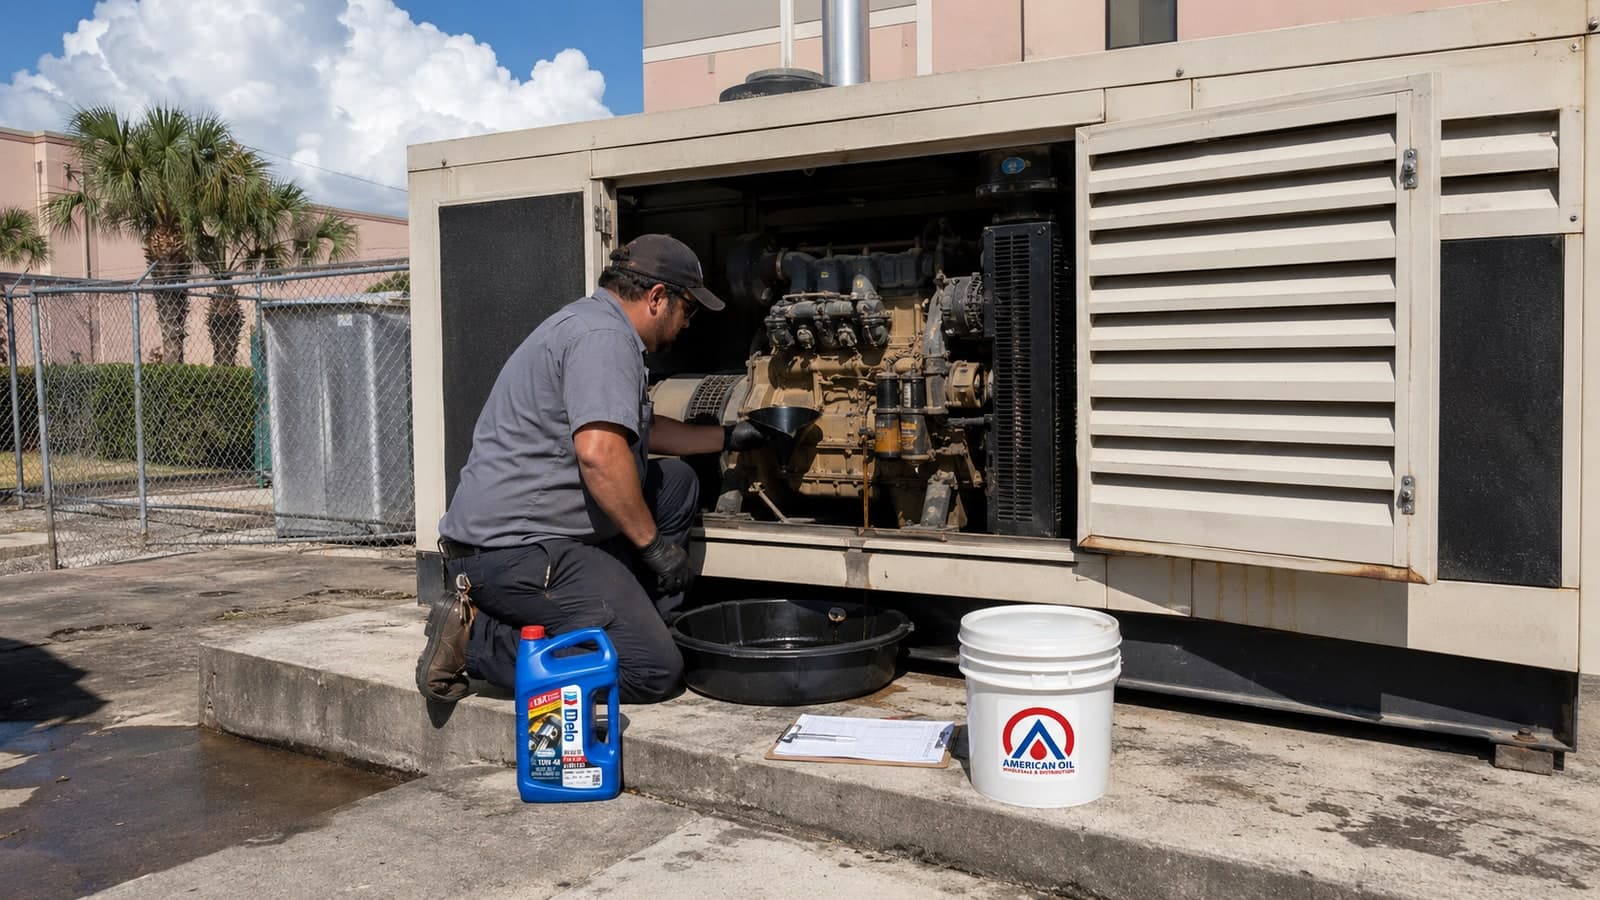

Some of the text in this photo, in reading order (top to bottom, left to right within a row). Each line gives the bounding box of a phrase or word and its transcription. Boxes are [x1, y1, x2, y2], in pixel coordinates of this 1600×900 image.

[564, 709, 578, 742] Delo
[1003, 759, 1075, 770] AMERICAN OIL
